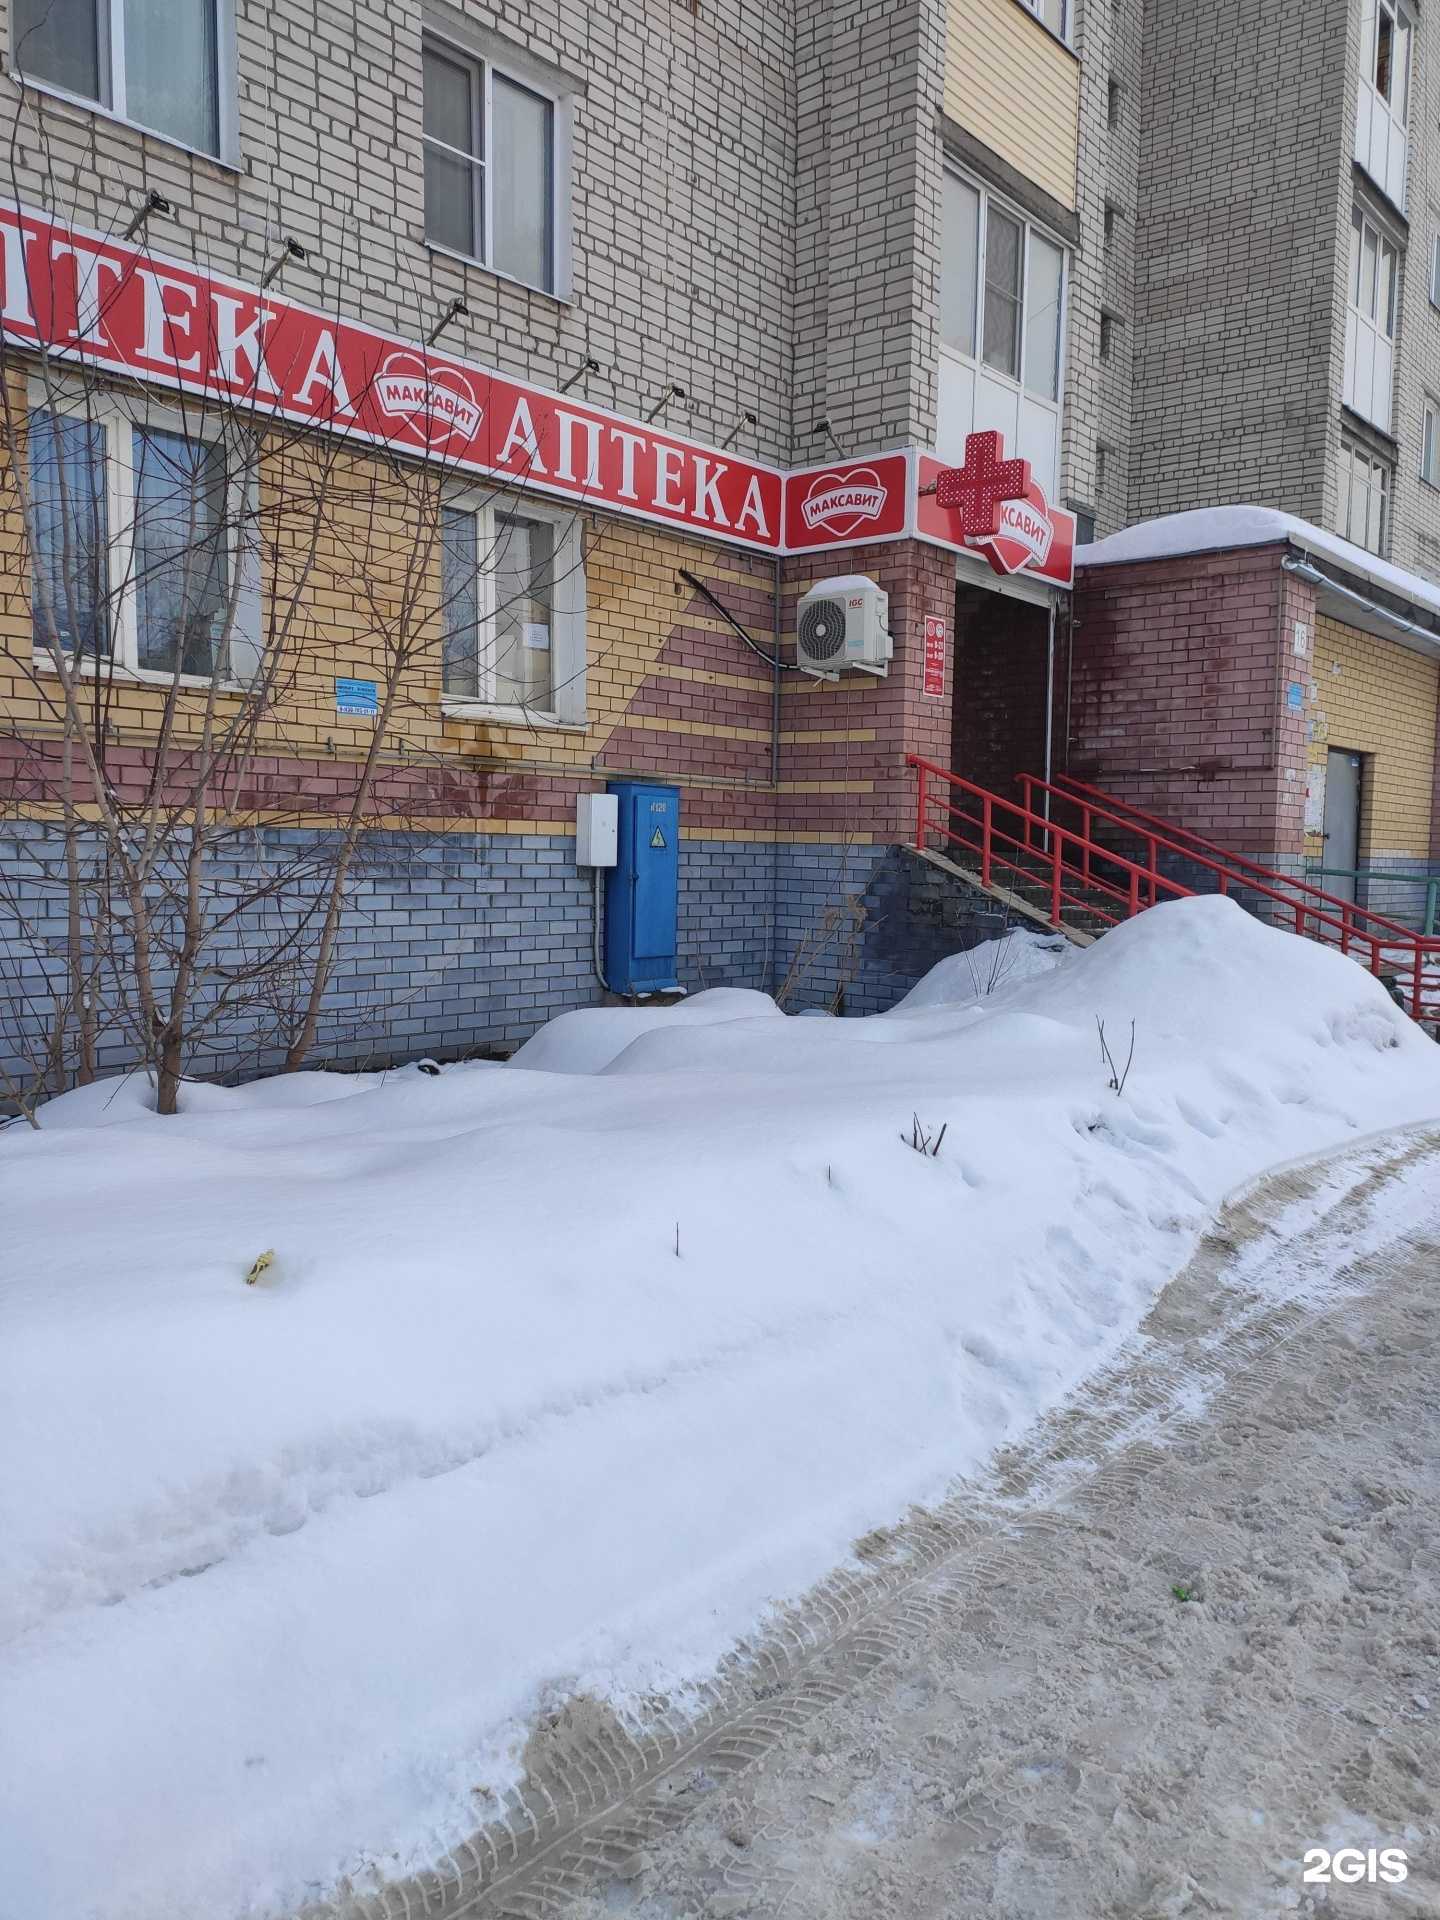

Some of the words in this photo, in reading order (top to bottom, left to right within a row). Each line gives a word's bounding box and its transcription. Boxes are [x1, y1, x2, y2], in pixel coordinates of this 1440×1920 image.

[386, 385, 473, 425] МАКСАВИТ
[496, 397, 771, 538] АПТЕКА
[809, 493, 879, 517] МАКСАВИТ
[1001, 505, 1046, 546] КСАВИТ
